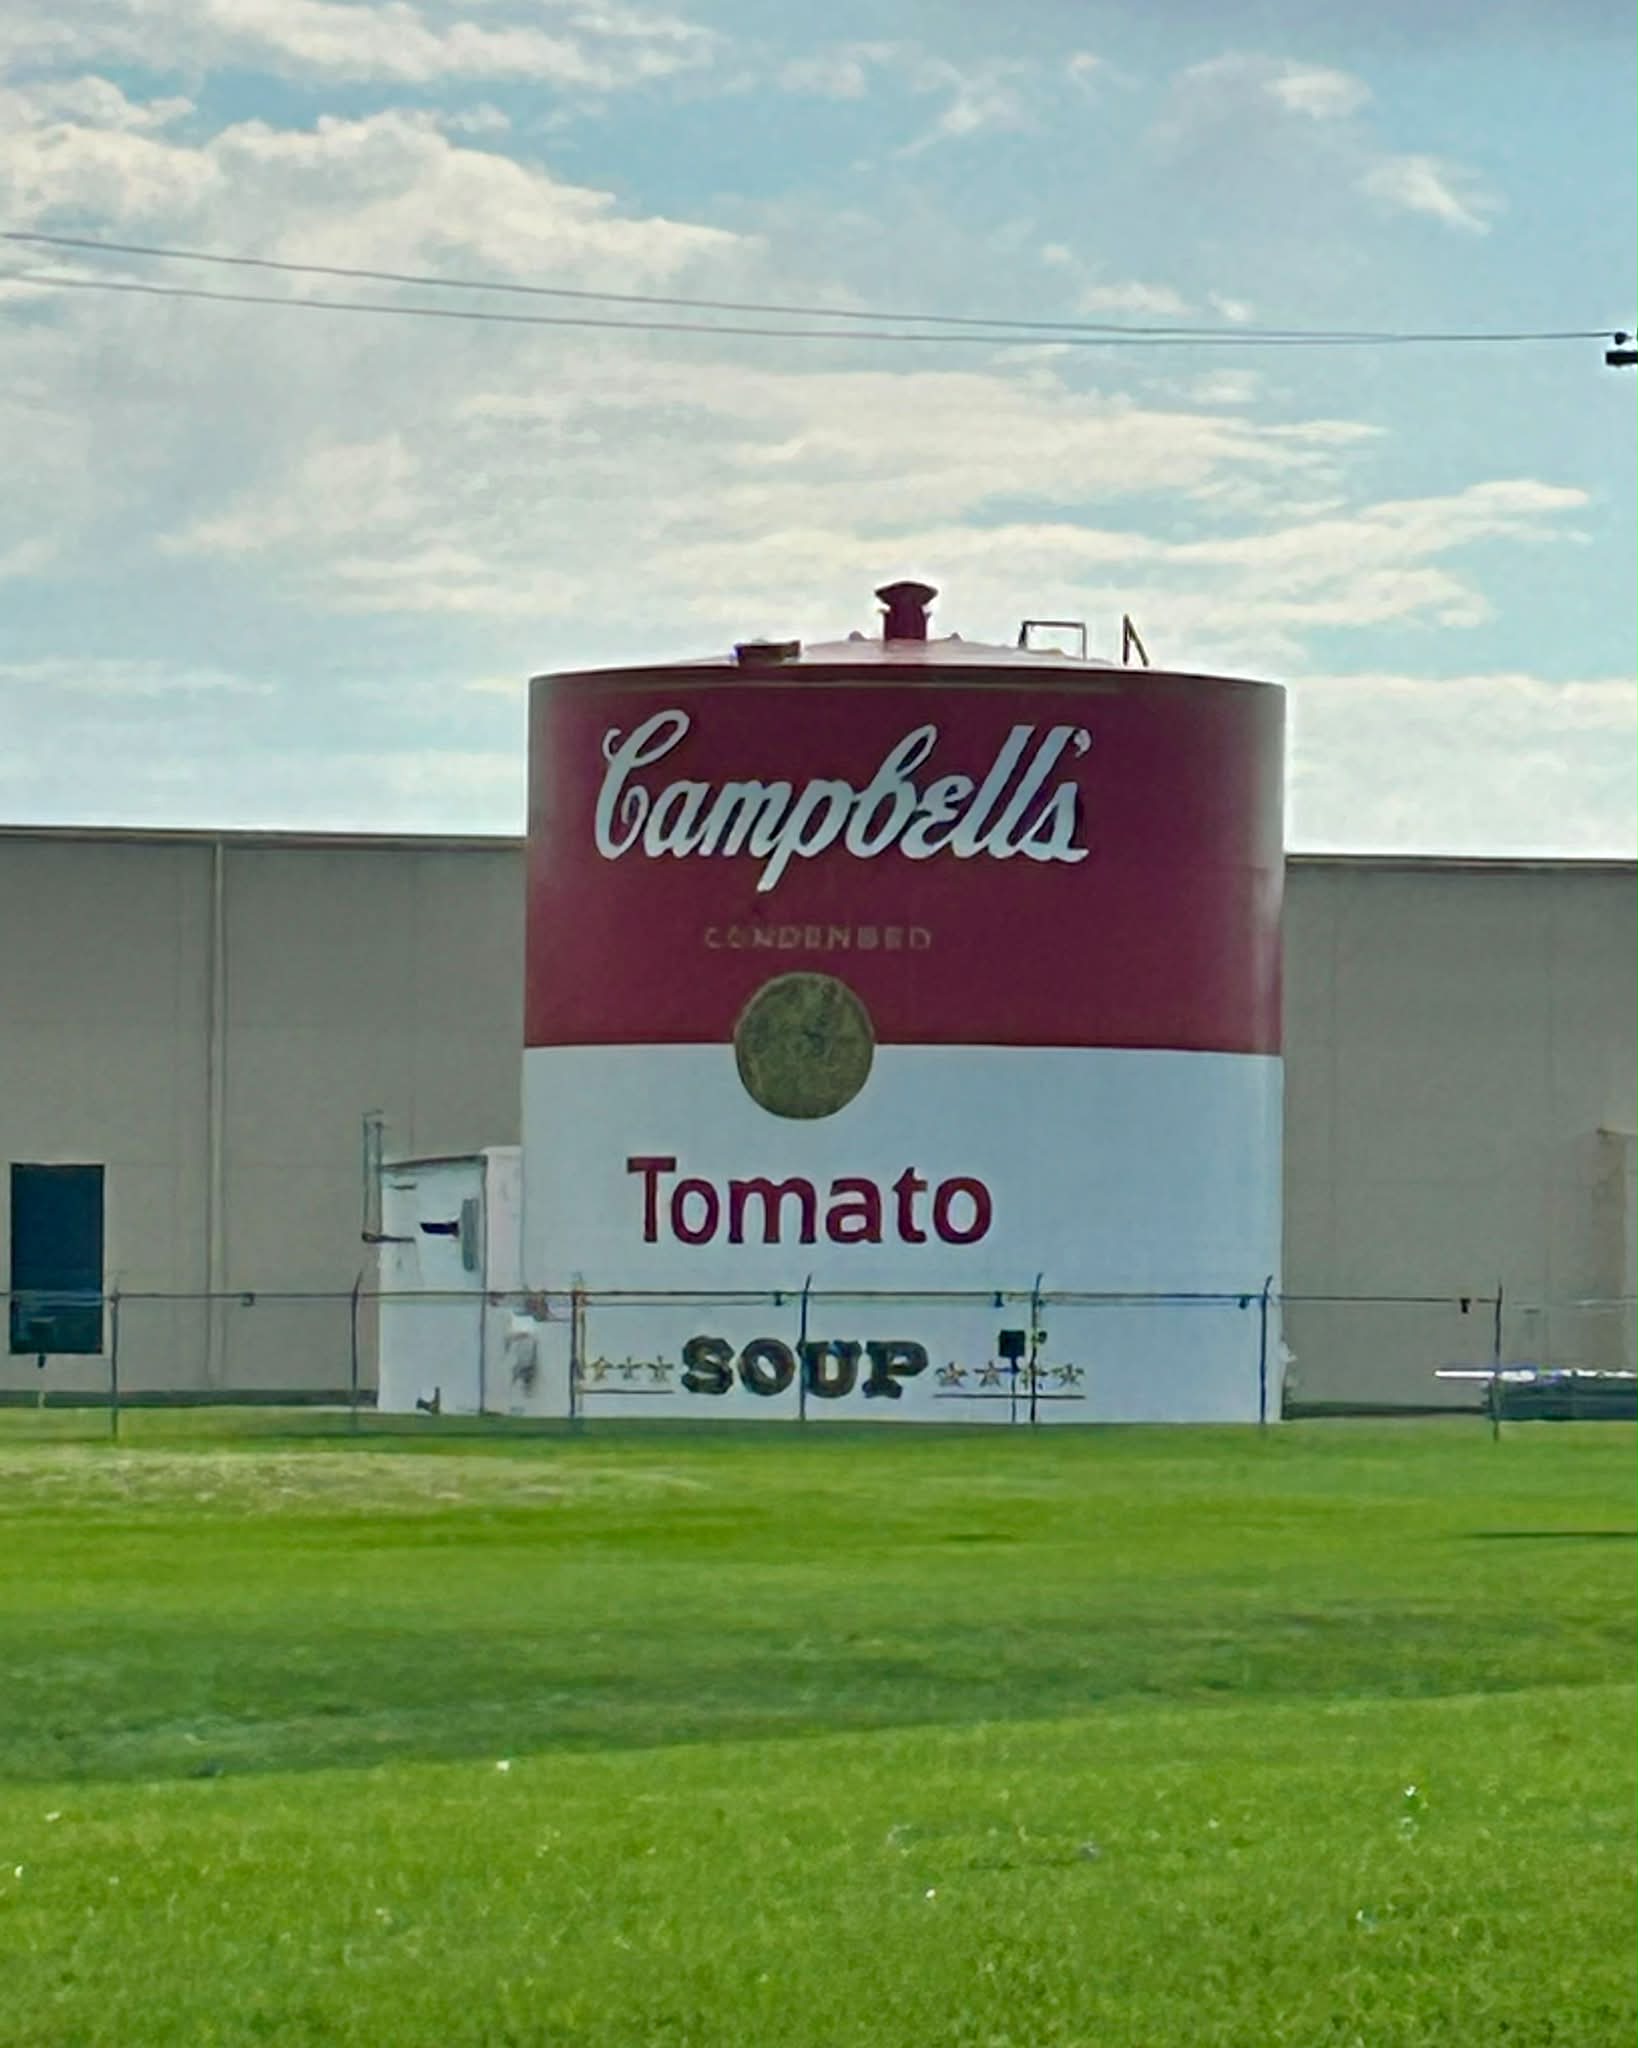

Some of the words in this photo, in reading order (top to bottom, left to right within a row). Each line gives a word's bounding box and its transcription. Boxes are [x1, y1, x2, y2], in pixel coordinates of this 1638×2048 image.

[594, 708, 1092, 892] Campbell's
[626, 1156, 993, 1246] Tomato
[681, 1333, 928, 1399] SOUP
